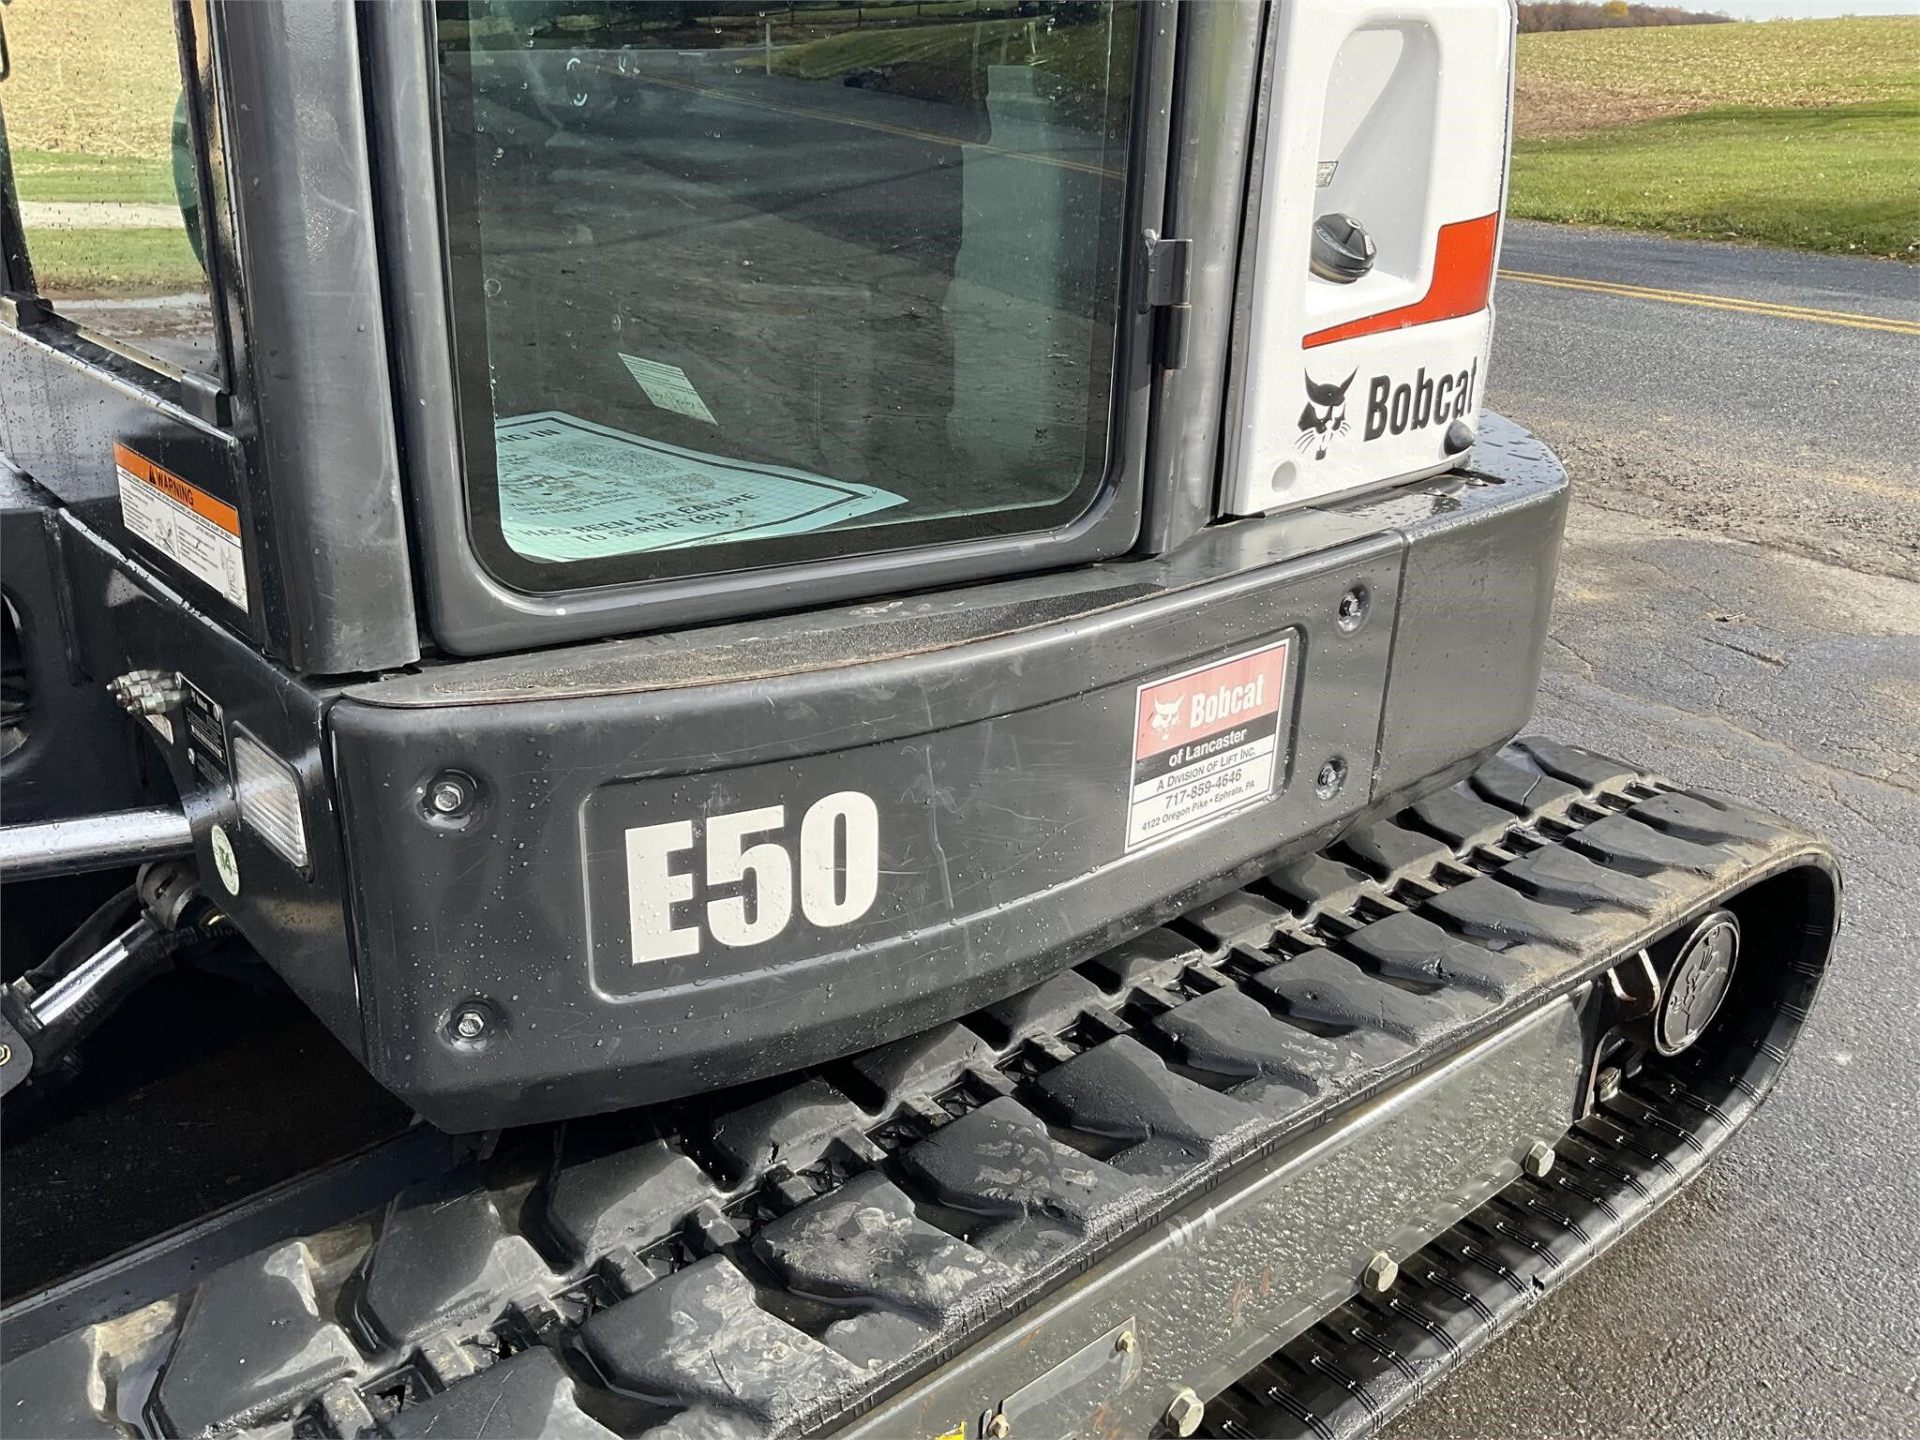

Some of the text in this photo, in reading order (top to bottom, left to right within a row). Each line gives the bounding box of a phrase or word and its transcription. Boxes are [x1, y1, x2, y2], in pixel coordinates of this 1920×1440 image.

[1364, 356, 1477, 442] Bobcat
[157, 470, 195, 507] WARNING
[571, 519, 634, 533] BEEN
[574, 533, 608, 543] TO
[608, 519, 685, 538] SERVE
[1189, 673, 1265, 729] Bobcat
[1168, 727, 1248, 767] of Lancaster
[1142, 816, 1161, 831] 4122
[1161, 806, 1191, 823] Oregon
[1191, 798, 1209, 812] Pike
[1245, 780, 1255, 791] PA
[1156, 780, 1165, 792] A
[1165, 768, 1243, 809] 717-859-4646
[625, 791, 879, 964] E50
